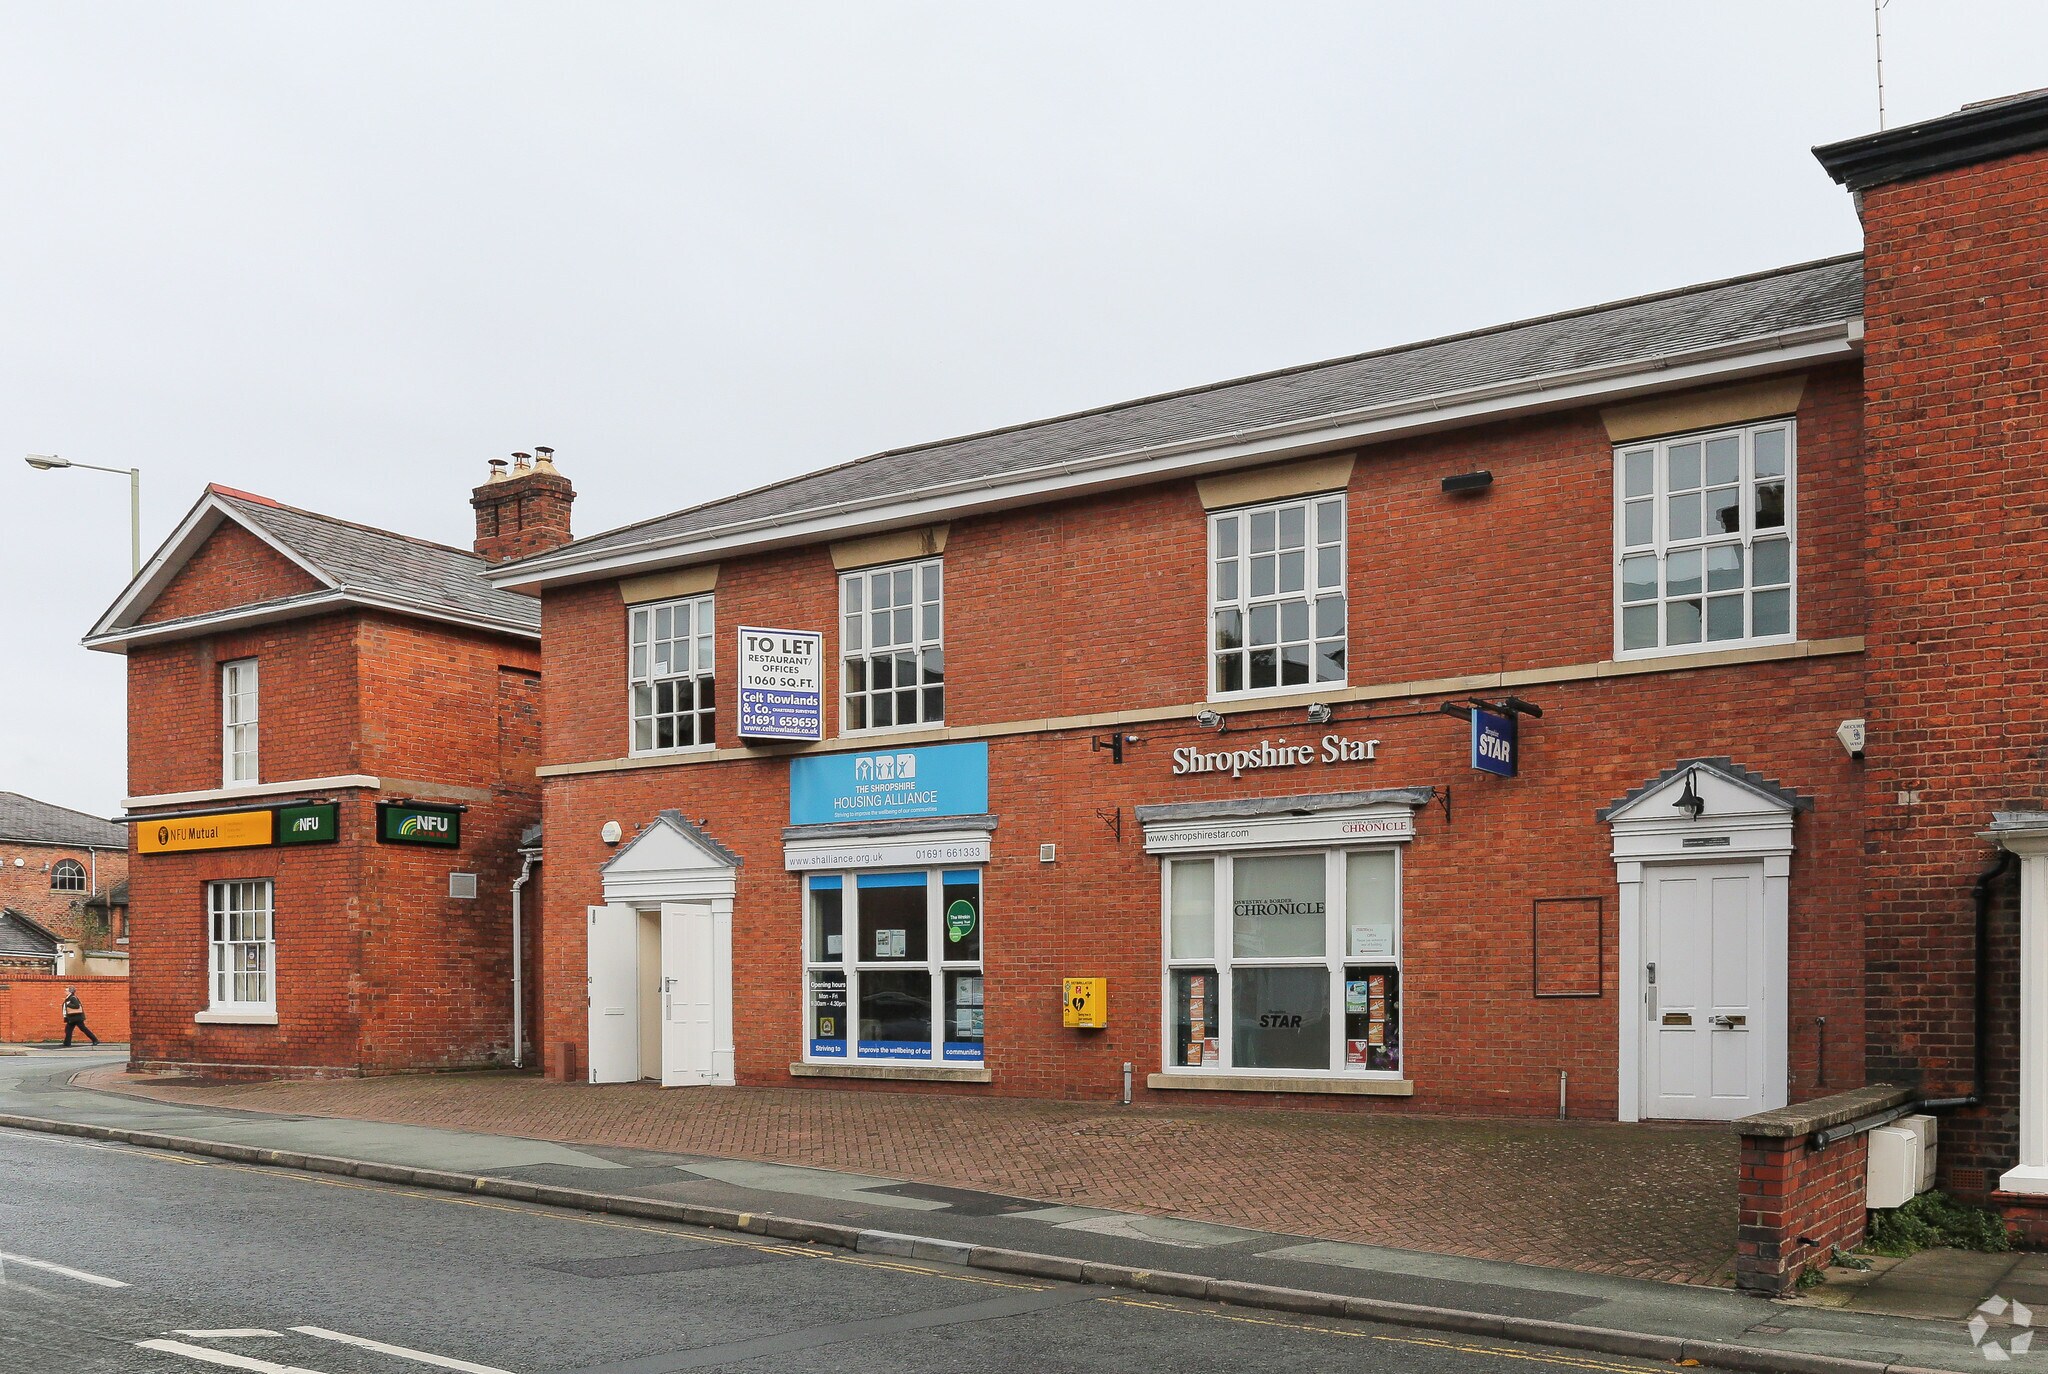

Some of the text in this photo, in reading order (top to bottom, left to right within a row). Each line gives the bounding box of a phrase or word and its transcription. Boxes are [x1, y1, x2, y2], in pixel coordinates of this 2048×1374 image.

[747, 637, 814, 655] TO LET
[748, 654, 813, 666] RESTAURANT/
[762, 664, 800, 674] OFFICES
[748, 675, 814, 689] 1060 SQ.FT.
[743, 692, 818, 706] Celt Rowlands
[743, 702, 751, 713] &
[754, 703, 772, 714] Co.
[743, 714, 818, 728] 01691 659659
[743, 725, 818, 735] www.celtrowlands.co.uk
[1479, 734, 1510, 763] STAR
[1173, 735, 1380, 778] Shropshire Star
[856, 781, 916, 793] THE SHROPSHIRE
[834, 790, 938, 809] HOUSING ALLIANCE
[299, 816, 319, 831] NFU
[416, 815, 448, 832] NFU
[1342, 822, 1407, 833] CHRONICLE
[170, 828, 187, 841] NFU
[188, 826, 219, 840] Mutual
[1148, 828, 1249, 842] www.shropshirestar.com
[789, 848, 981, 866] www.shalliance.org.uk 01691 661333
[1234, 902, 1325, 916] CHRONICLE
[810, 981, 831, 989] Opening
[1259, 1014, 1302, 1028] STAR
[890, 1047, 914, 1055] wellbeing
